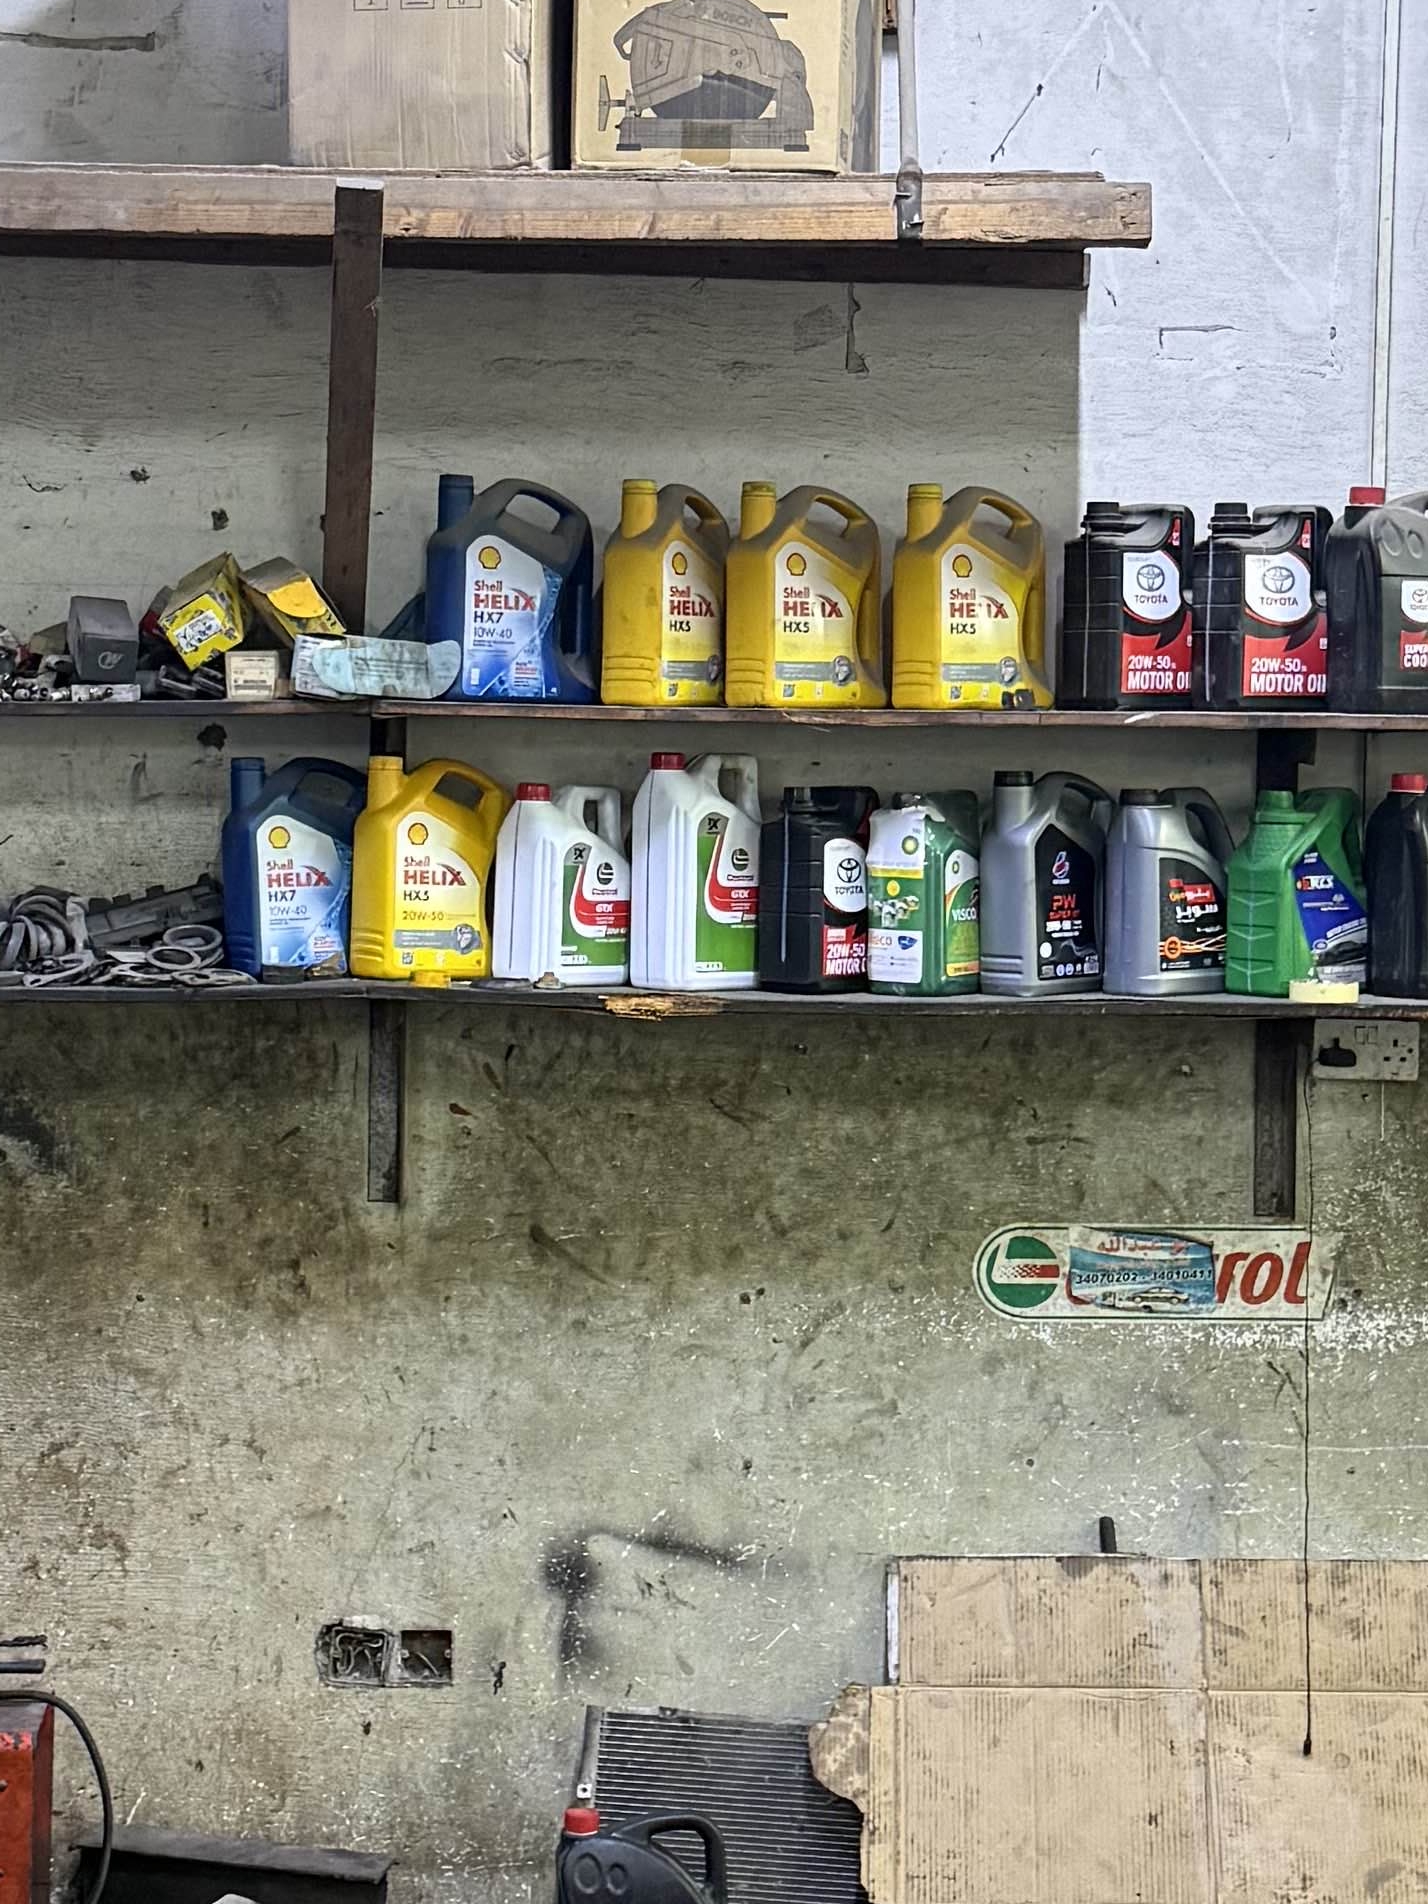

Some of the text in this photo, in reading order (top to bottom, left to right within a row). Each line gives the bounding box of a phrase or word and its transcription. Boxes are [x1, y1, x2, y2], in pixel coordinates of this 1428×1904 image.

[474, 580, 503, 592] Shell
[670, 586, 691, 598] Shell
[783, 587, 810, 599] Shell
[950, 589, 976, 600] Shell
[474, 590, 537, 611] HELIX
[1134, 594, 1168, 605] TOYOTA
[1259, 596, 1299, 607] TOYOTA
[669, 597, 716, 618] HELIX
[474, 612, 504, 624] HX7
[669, 620, 691, 632] HX5
[783, 621, 810, 633] HX5
[950, 623, 976, 635] HX5
[474, 627, 513, 639] 10W-40
[1128, 655, 1171, 670] 20W-50
[1251, 658, 1300, 673] 20W-50
[1128, 672, 1173, 691] MOTOR
[1250, 673, 1303, 693] MOTOR
[267, 859, 293, 871] Shell
[404, 856, 430, 868] Shell
[266, 868, 333, 888] HELIX
[403, 866, 467, 886] HELIX
[268, 890, 296, 902] HX7
[835, 886, 864, 895] TOYOTA
[952, 908, 977, 921] VISCO
[827, 943, 865, 959] 20W-50
[826, 958, 861, 976] MOTOR
[1076, 1272, 1138, 1285] 34070202
